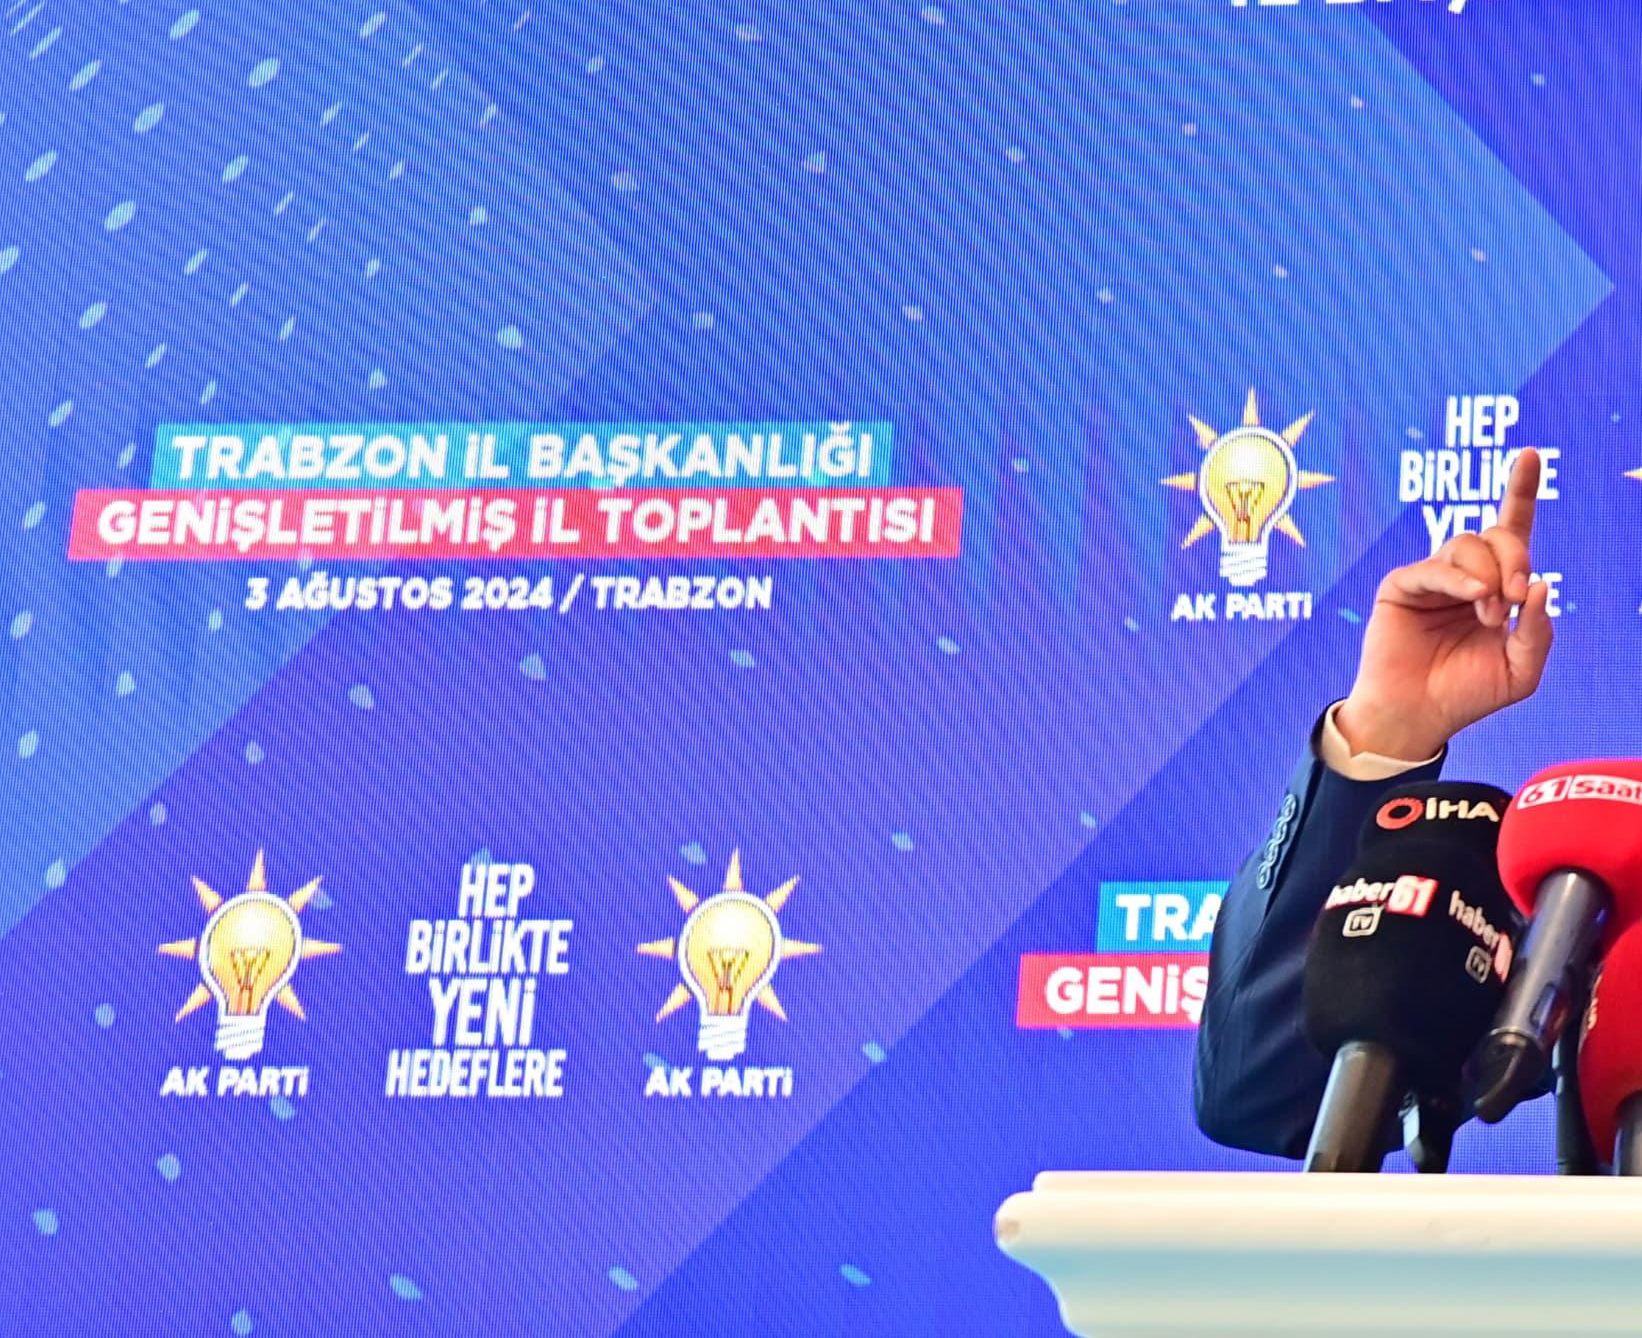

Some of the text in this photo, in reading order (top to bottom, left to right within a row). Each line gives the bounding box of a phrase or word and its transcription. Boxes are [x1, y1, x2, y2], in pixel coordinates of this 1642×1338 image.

[1446, 396, 1520, 448] HEP
[172, 435, 448, 480] TRABZON
[530, 423, 873, 488] BAŞKANLIĞI
[1401, 448, 1561, 503] BiRLiKE
[600, 498, 936, 544] TOPLANTISI
[246, 571, 773, 615] 3 AĞUSTOS 2024 / TRABZON
[1170, 594, 1218, 622] AK
[458, 864, 536, 918] HEP
[1116, 893, 1221, 941] TRA
[160, 1069, 209, 1096] AK
[386, 1050, 568, 1098] HEDEFLERE
[645, 1067, 692, 1097] AK
